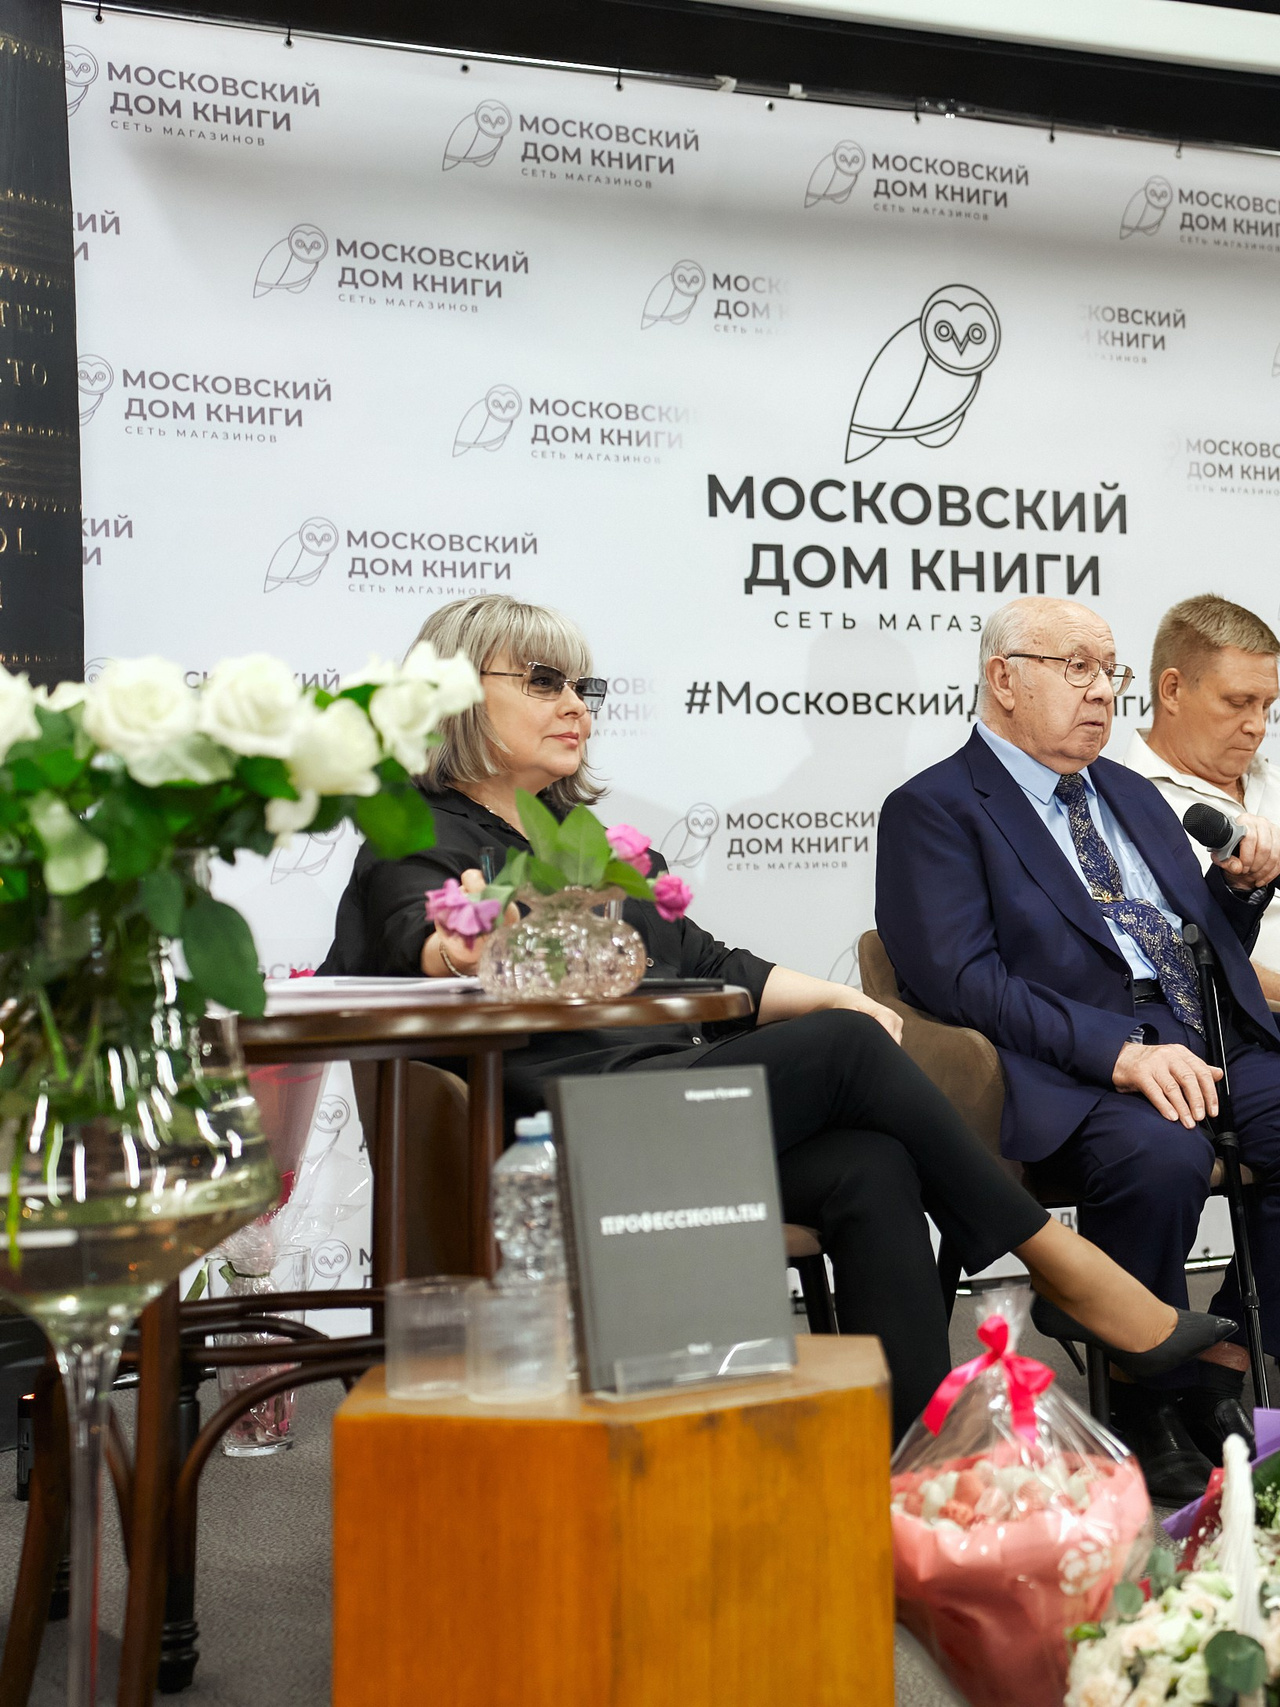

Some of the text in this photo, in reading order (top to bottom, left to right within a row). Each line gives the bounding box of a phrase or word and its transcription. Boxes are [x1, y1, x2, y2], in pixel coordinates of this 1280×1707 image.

[108, 62, 320, 107] МОСКОВСКИЙ
[110, 92, 290, 131] ДОМ КНИГИ
[520, 114, 699, 151] МОСКОВСКИЙ
[521, 142, 674, 175] ДОМ КНИГИ
[872, 153, 1028, 186] МОСКОВСКИЙ
[874, 179, 1007, 208] ДОМ КНИГИ
[1180, 212, 1226, 232] ДОМ
[336, 239, 528, 274] МОСКОВСКИЙ
[338, 267, 501, 298] ДОМ КНИГИ
[714, 299, 768, 320] ДОМ
[1099, 331, 1165, 351] КНИГИ
[123, 369, 331, 401] МОСКОВСКИЙ
[125, 398, 302, 427] ДОМ КНИГИ
[530, 398, 697, 423] МОСКОВСКИ
[531, 424, 590, 445] ДОМ
[1188, 462, 1233, 479] ДОМ
[708, 474, 1127, 534] МОСКОВСКИЙ
[347, 530, 537, 554] МОСКОВСКИЙ
[348, 557, 510, 580] ДОМ КНИГИ
[744, 543, 1099, 596] ДОМ КНИГИ
[727, 812, 876, 832] МОСКОВСКИ
[727, 836, 868, 858] ДОМ КНИГИ
[600, 1202, 767, 1236] ПРОФЕССИОНАЛЫ
